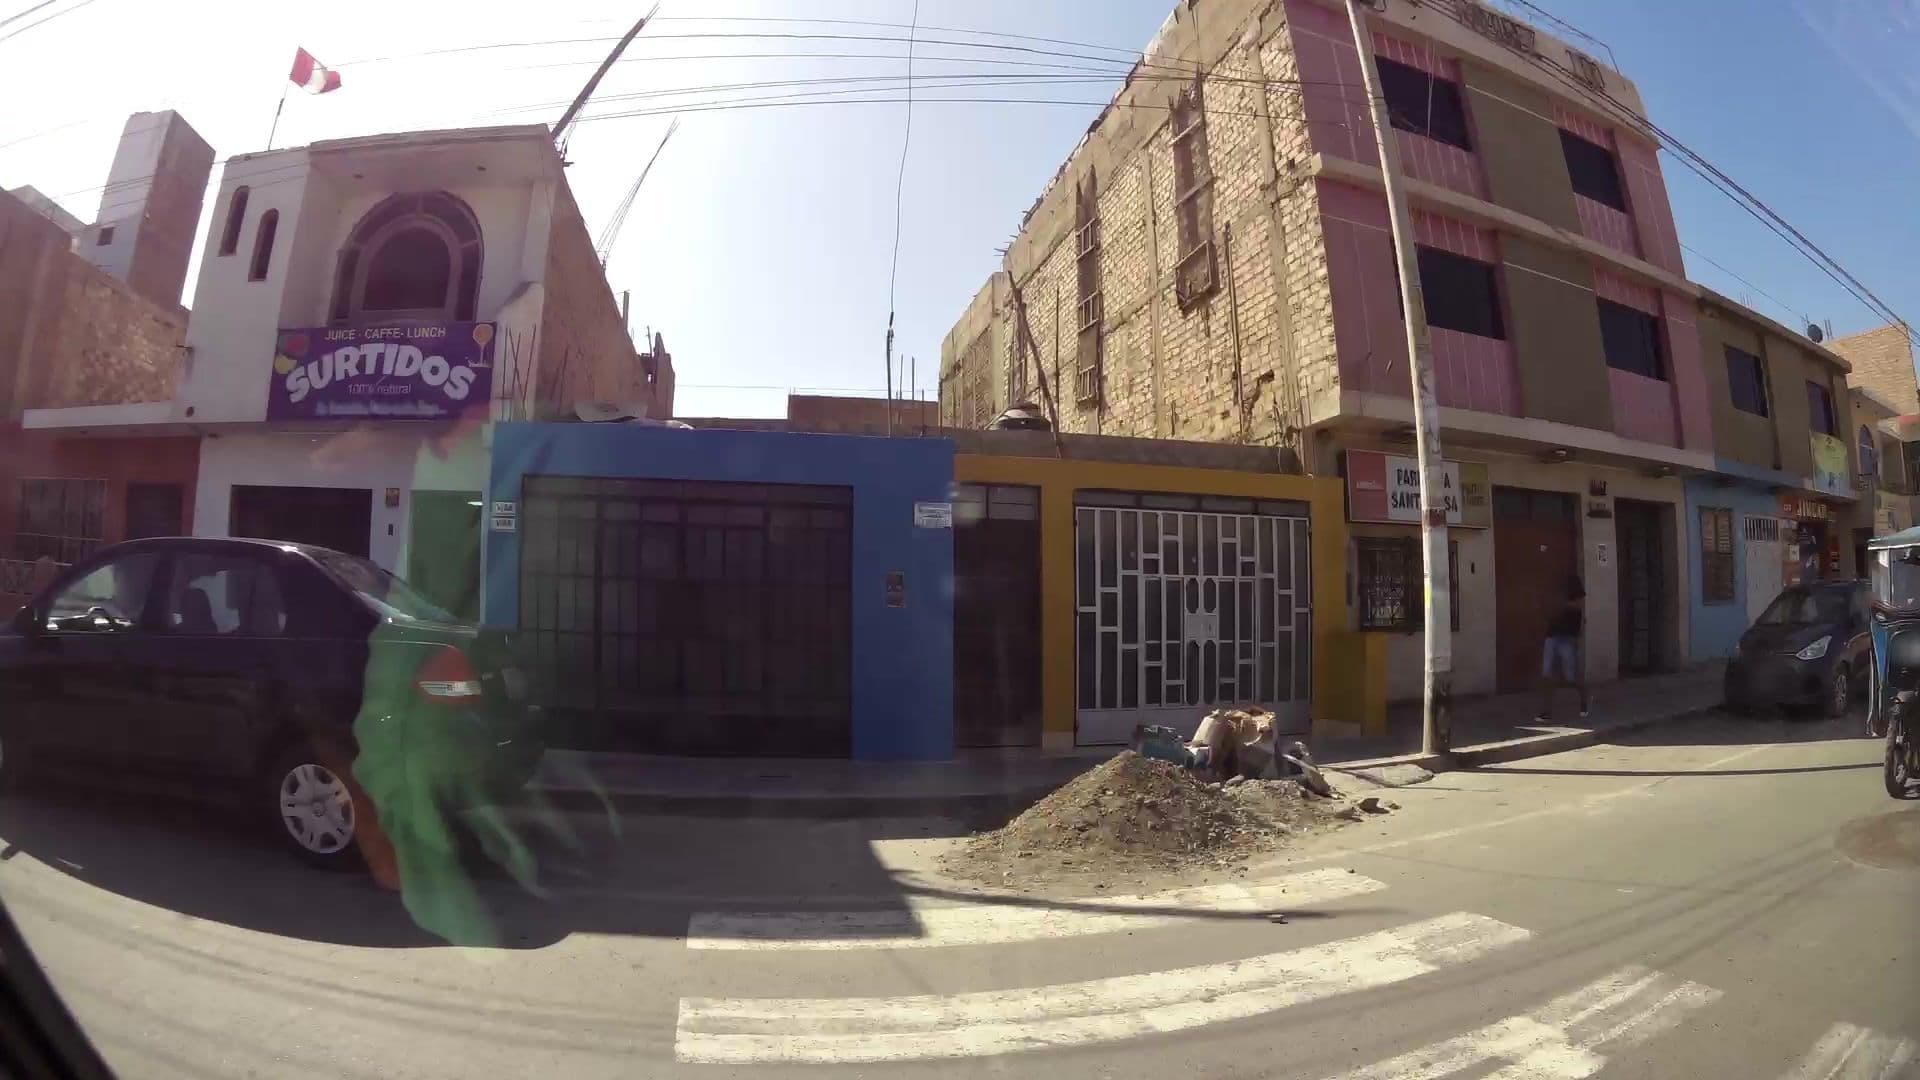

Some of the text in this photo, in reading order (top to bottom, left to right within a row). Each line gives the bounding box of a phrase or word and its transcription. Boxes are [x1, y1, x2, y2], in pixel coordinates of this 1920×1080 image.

[325, 328, 355, 341] JUICE
[407, 327, 446, 338] LUNCH
[285, 343, 477, 403] SURTIDOS
[1391, 490, 1421, 509] SANT
